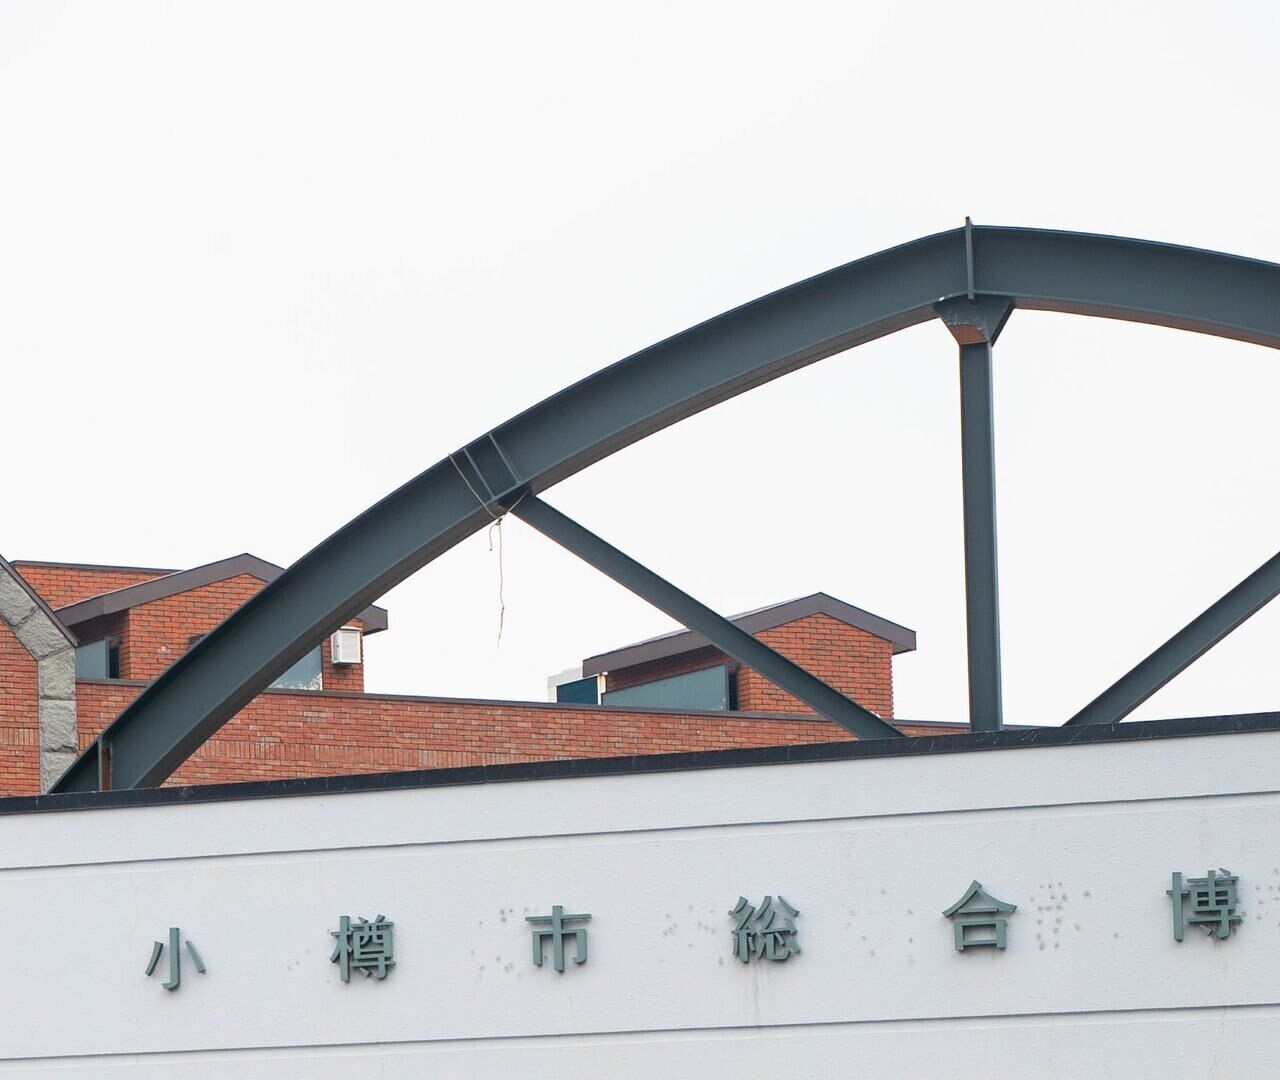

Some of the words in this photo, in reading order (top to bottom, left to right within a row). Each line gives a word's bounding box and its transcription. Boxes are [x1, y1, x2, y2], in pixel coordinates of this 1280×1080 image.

[143, 866, 1243, 992] 小樽市総合博
